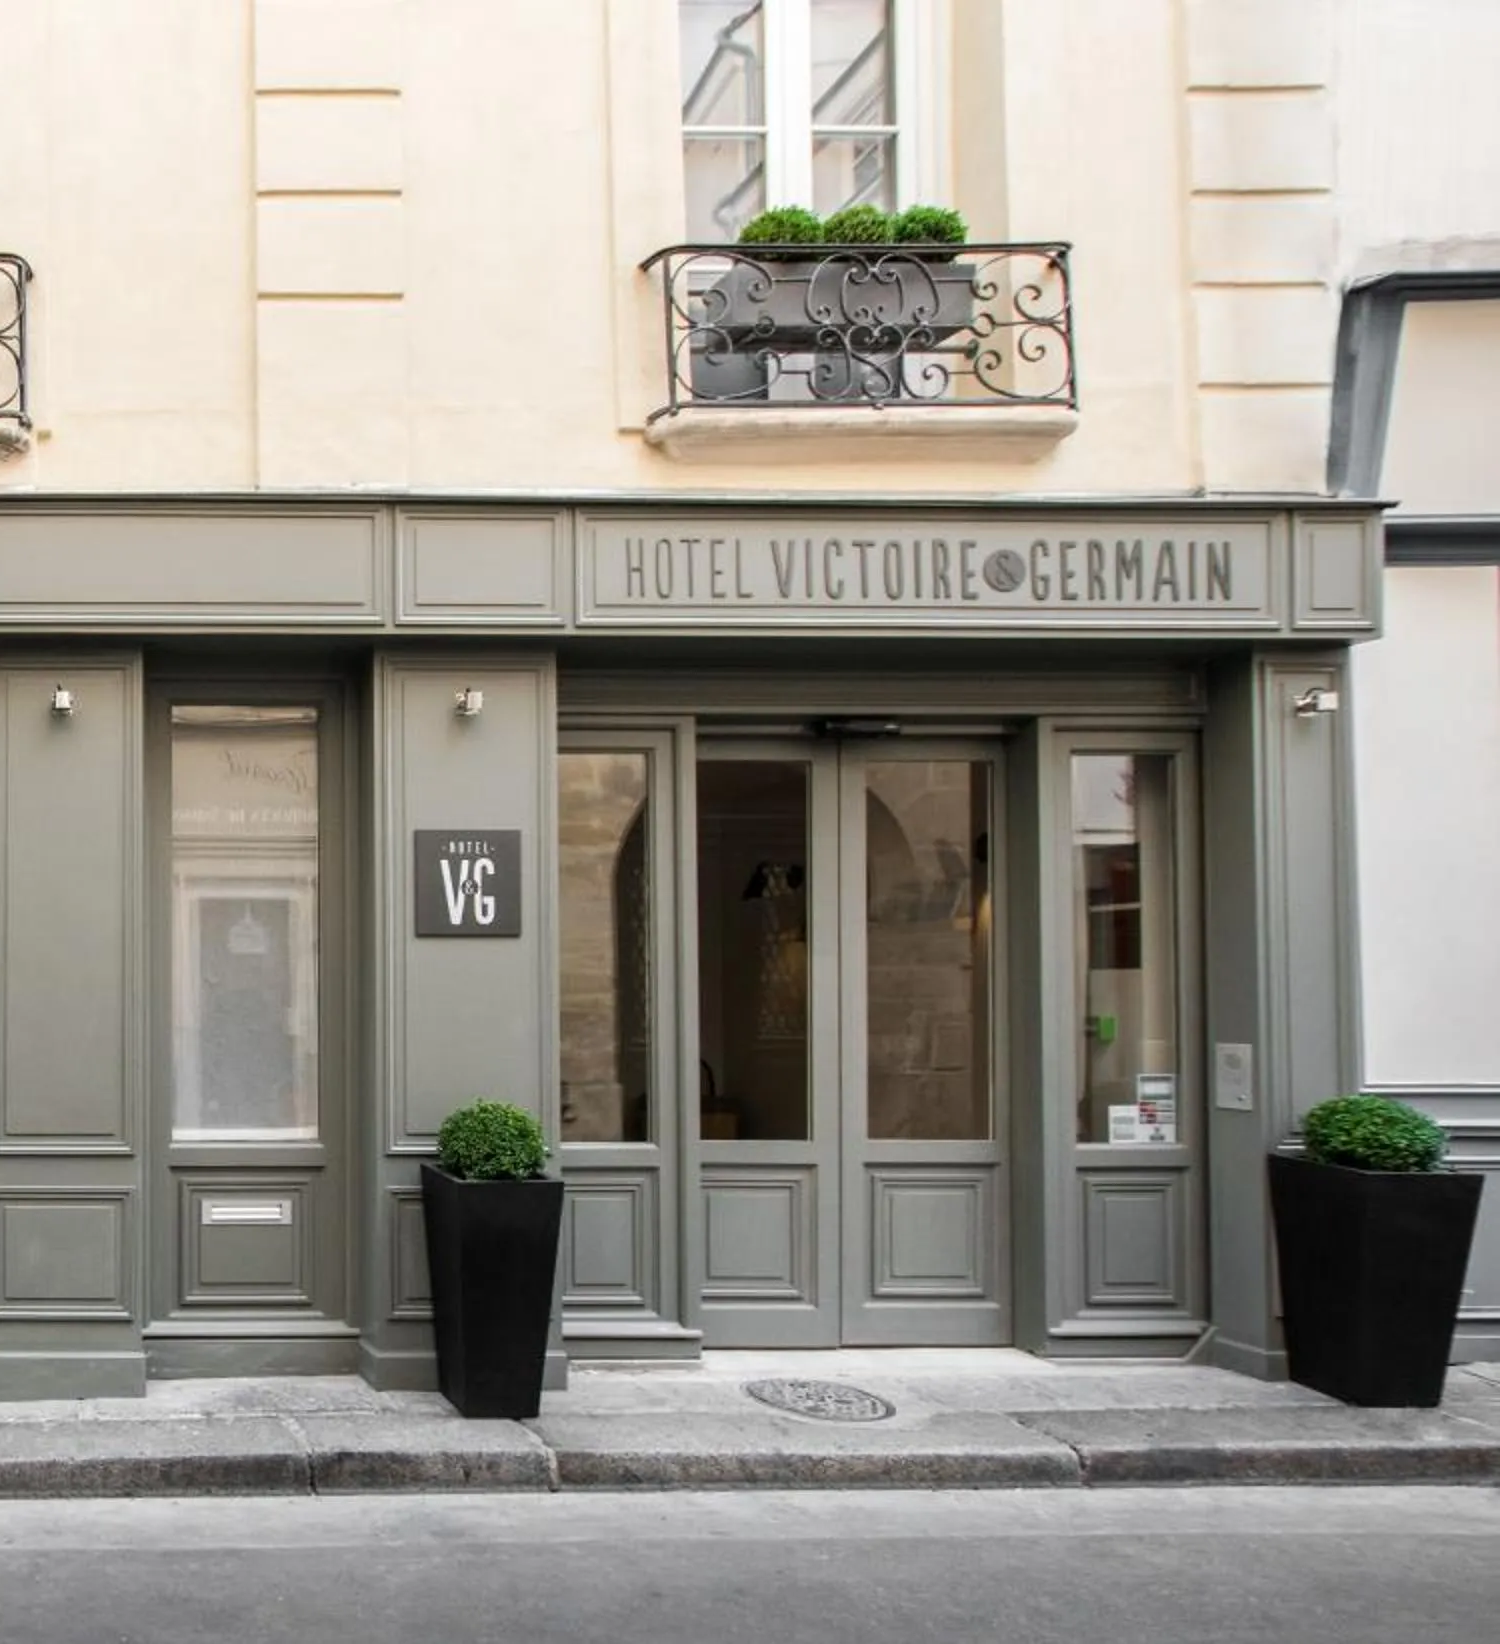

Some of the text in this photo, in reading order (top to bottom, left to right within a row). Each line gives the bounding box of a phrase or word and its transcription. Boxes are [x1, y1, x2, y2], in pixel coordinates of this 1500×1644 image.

[624, 538, 753, 600] HOTEL
[769, 539, 980, 601] VICTOIRE
[1029, 540, 1233, 602] GERMAIN
